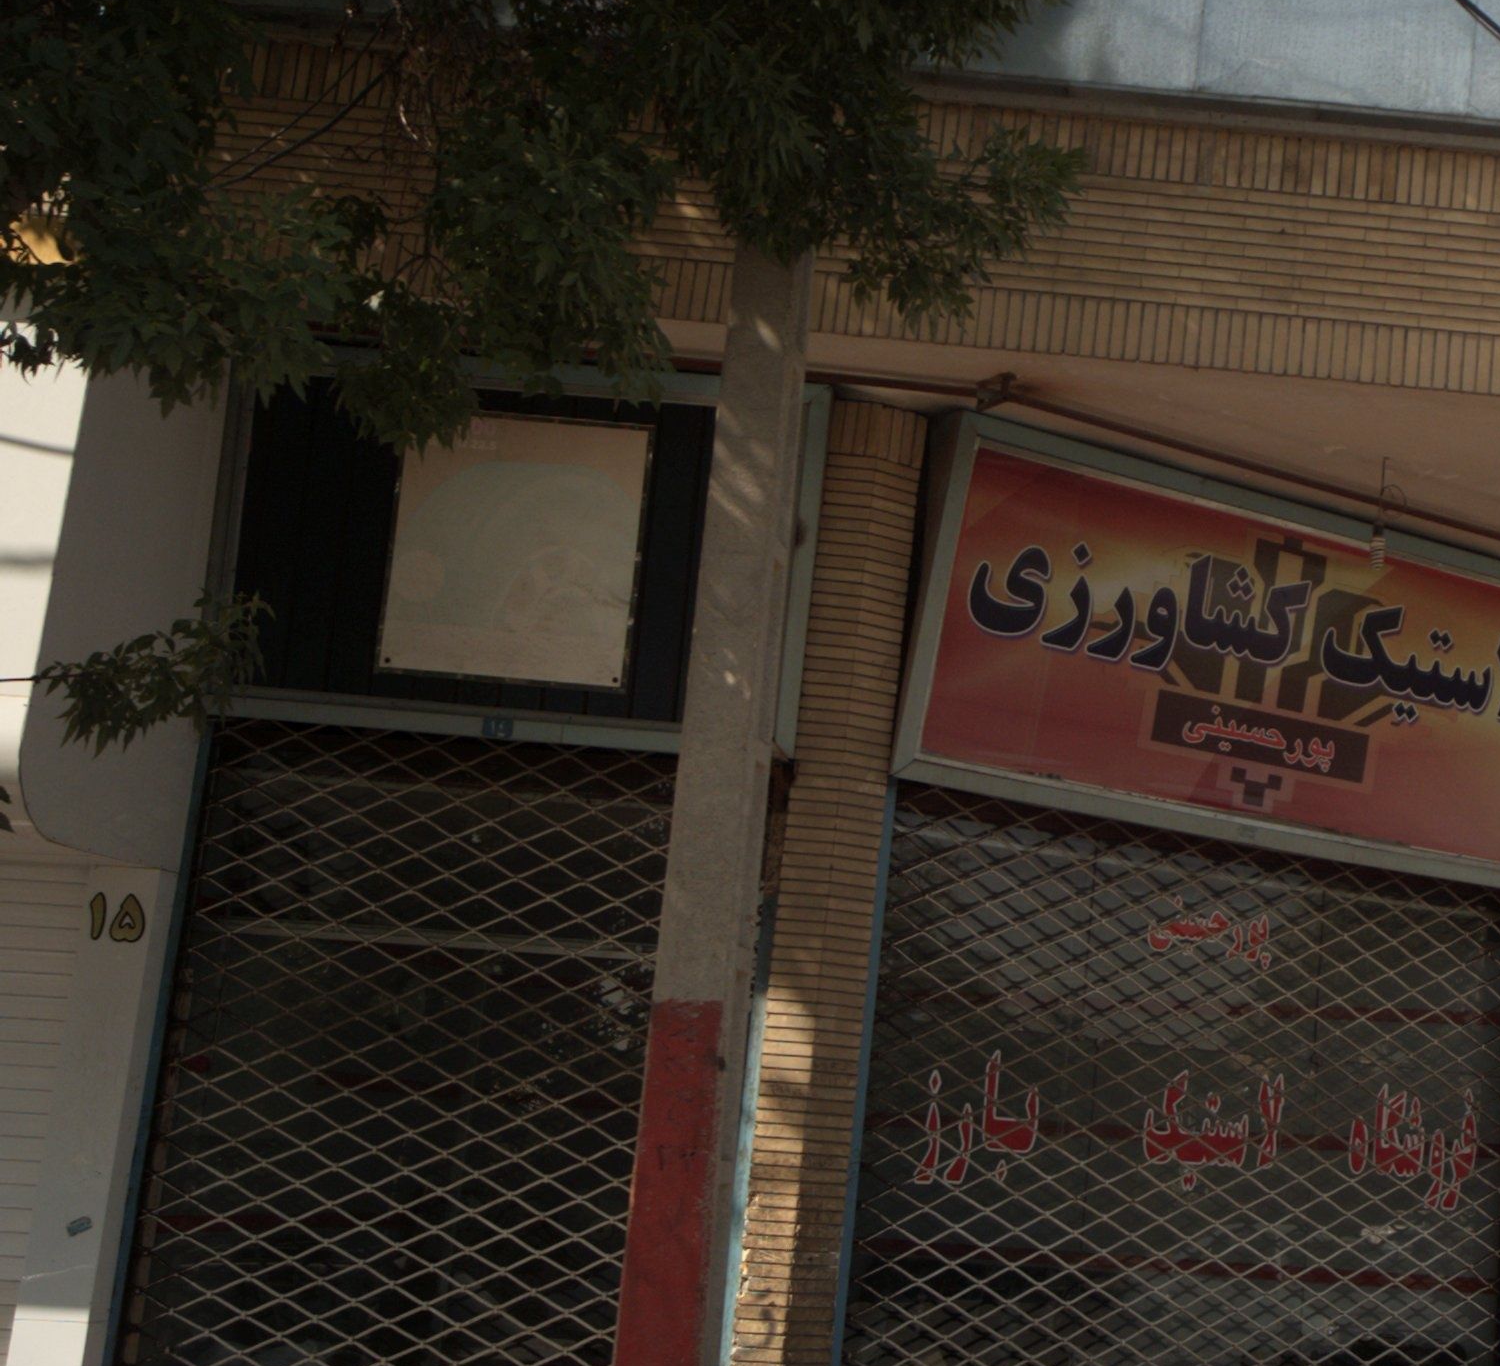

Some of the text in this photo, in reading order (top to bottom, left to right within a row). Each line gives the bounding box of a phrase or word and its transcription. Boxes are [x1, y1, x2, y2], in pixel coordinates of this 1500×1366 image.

[967, 541, 1313, 671] کشاورزی
[90, 891, 146, 943] ۱۵
[913, 1049, 1477, 1211] فروشگاه لاستیک بارز
